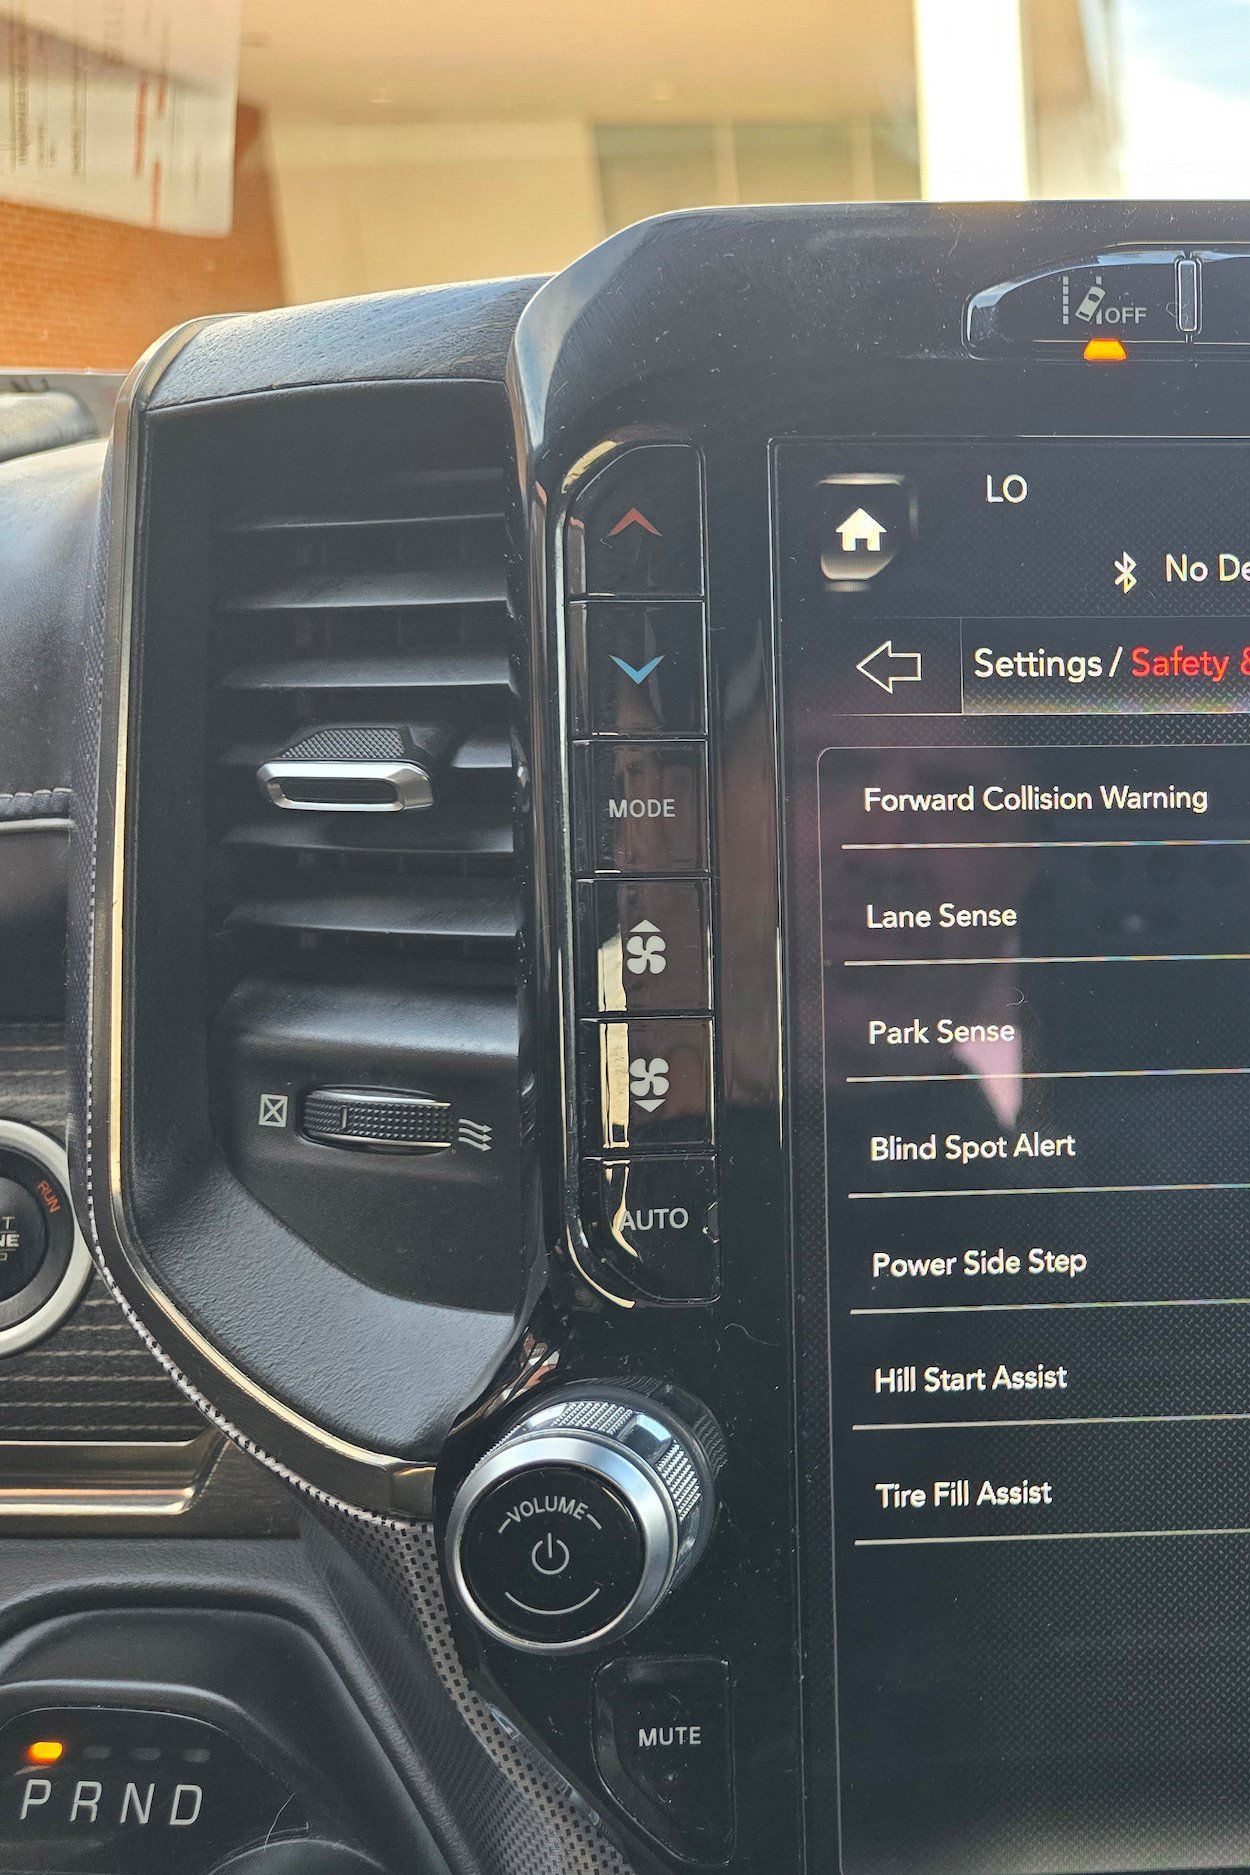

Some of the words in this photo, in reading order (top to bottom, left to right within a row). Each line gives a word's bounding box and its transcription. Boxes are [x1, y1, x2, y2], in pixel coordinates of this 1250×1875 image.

[1102, 306, 1148, 325] OFF
[986, 474, 1028, 504] LO
[1165, 553, 1209, 582] No
[1131, 644, 1230, 683] Safety
[608, 798, 676, 818] MODE
[864, 785, 975, 812] Forward
[982, 784, 1093, 811] Collision
[1099, 784, 1208, 814] Warning
[866, 904, 932, 929] Lane
[938, 902, 1018, 928] Sense
[869, 1018, 930, 1045] Park
[936, 1018, 1018, 1044] Sense
[870, 1133, 937, 1162] Blind
[945, 1134, 1008, 1165] Spot
[1012, 1131, 1077, 1158] Alert
[37, 1180, 61, 1214] RUN
[619, 1206, 690, 1232] AUTO
[872, 1252, 958, 1278] Power
[963, 1248, 1021, 1276] Side
[1028, 1248, 1088, 1278] Step
[875, 1365, 917, 1394] Hill
[923, 1366, 987, 1393] Start
[991, 1363, 1068, 1390] Assist
[875, 1482, 927, 1509] Tire
[934, 1479, 969, 1507] Fill
[976, 1479, 1053, 1506] Assist
[506, 1495, 588, 1523] VOLUME
[638, 1726, 702, 1747] MUTE
